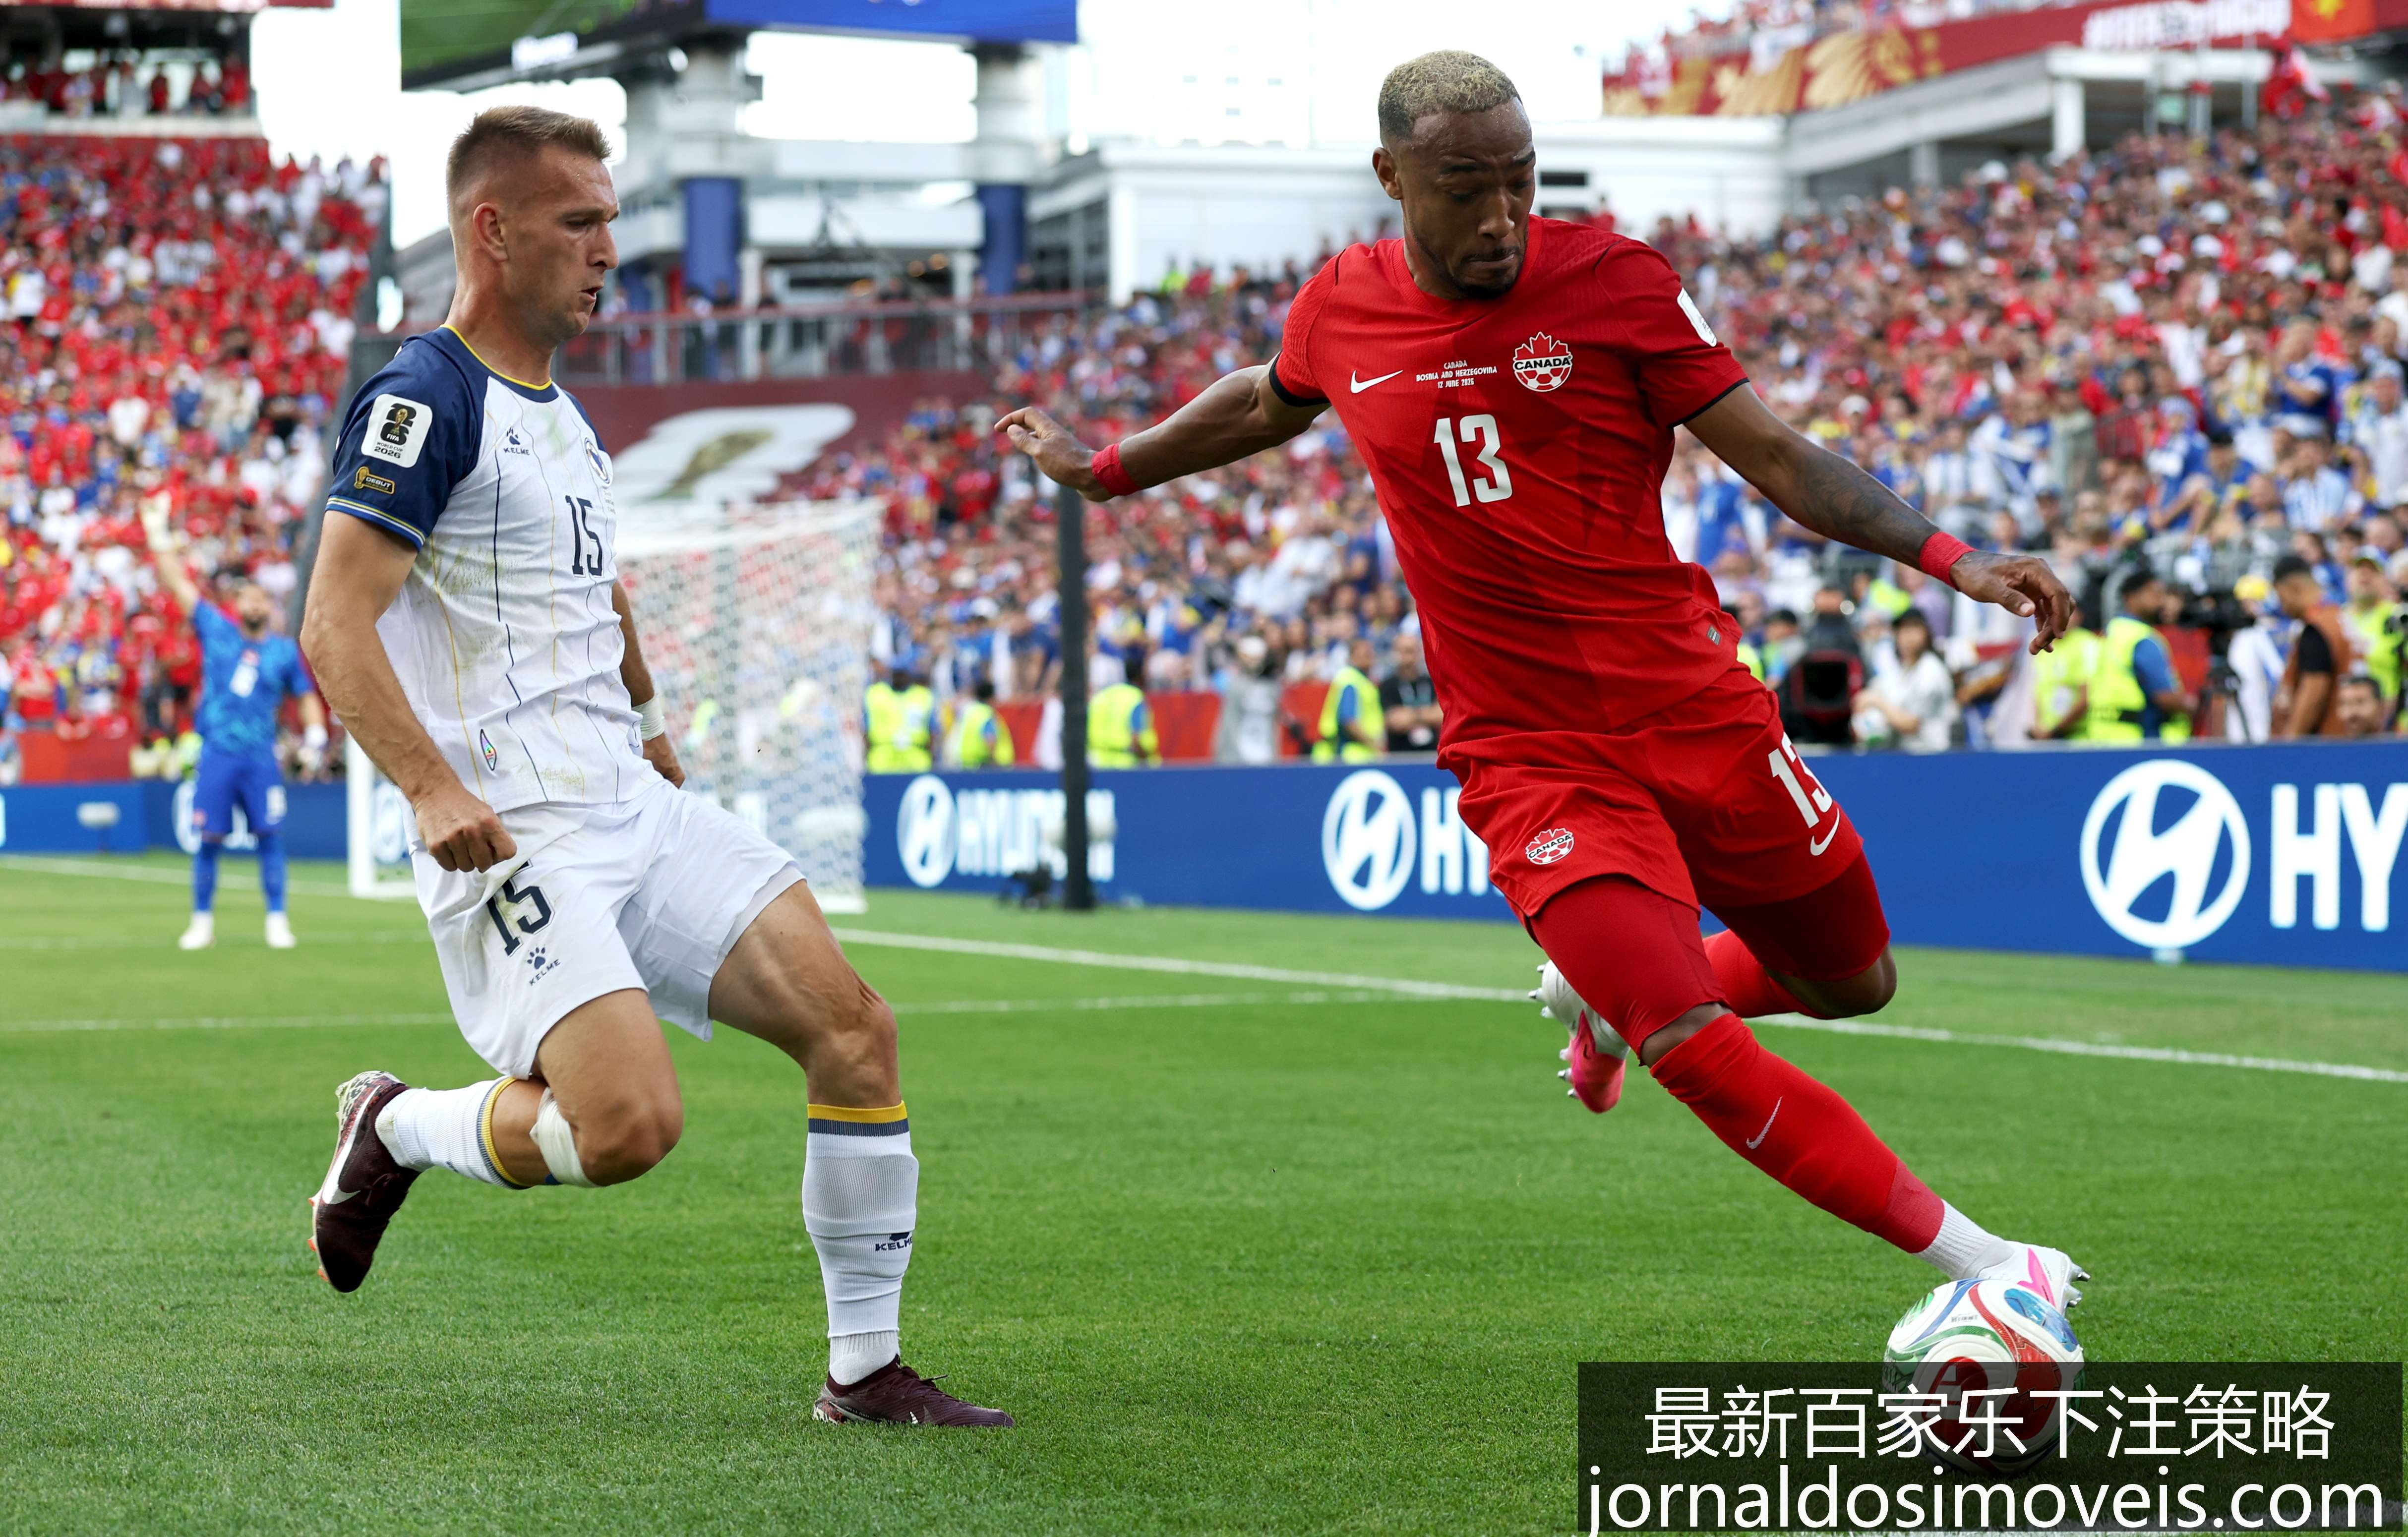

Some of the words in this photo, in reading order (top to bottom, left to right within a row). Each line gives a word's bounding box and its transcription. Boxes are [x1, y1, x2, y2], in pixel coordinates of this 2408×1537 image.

[1444, 359, 1468, 369] CANADA
[1514, 357, 1571, 370] CANADA
[1416, 372, 1439, 382] BOSNIA
[1455, 366, 1498, 377] HERZEGOVINA
[1445, 379, 1459, 388] JUNE
[1461, 378, 1474, 386] 2026
[386, 433, 400, 442] FIFA
[374, 446, 401, 459] 2026
[504, 447, 531, 456] KELME
[1434, 414, 1512, 507] 13
[365, 476, 392, 487] DEBUT
[565, 495, 603, 577] 15
[1529, 835, 1571, 858] CANADA
[486, 859, 554, 957] 15
[529, 958, 561, 986] KELME
